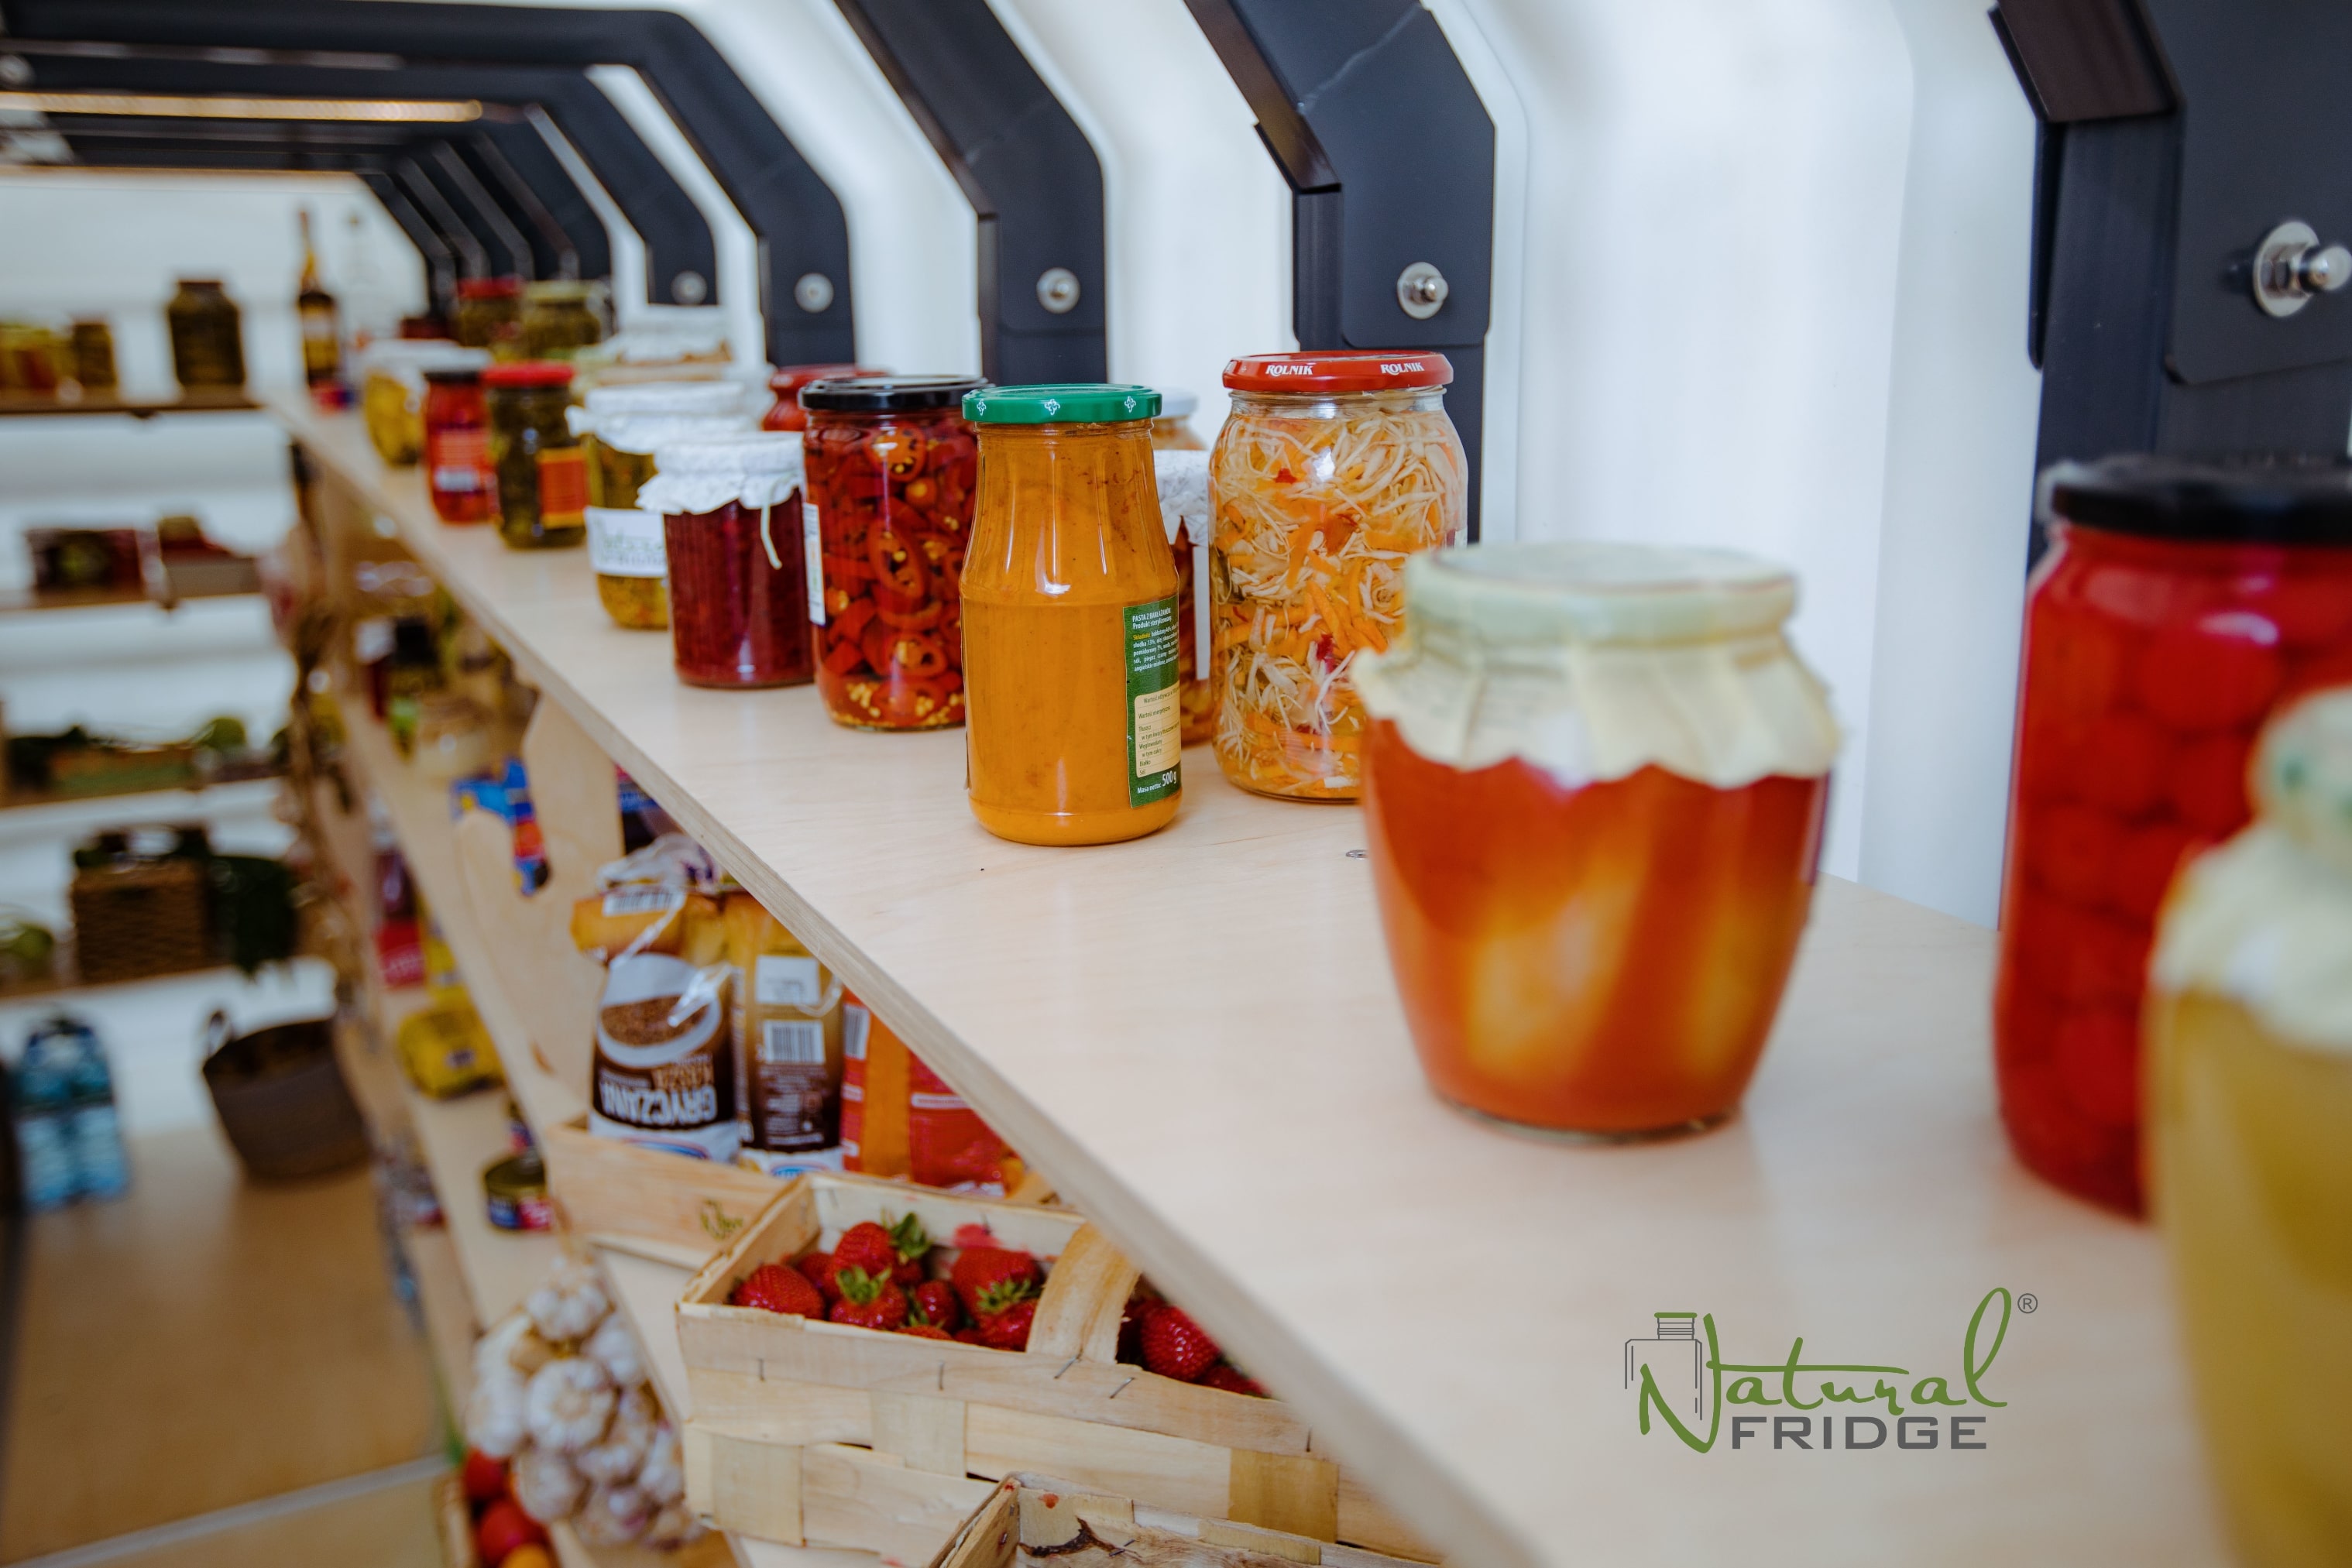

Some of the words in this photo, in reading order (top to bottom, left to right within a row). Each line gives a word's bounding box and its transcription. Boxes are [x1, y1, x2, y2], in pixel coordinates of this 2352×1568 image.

[1265, 365, 1313, 377] ROLNIK
[1380, 362, 1425, 376] ROLNIK
[1133, 620, 1150, 630] Produkt
[1138, 710, 1152, 719] Wartość
[1137, 786, 1149, 794] Masa
[1149, 782, 1162, 791] netto:
[1162, 770, 1173, 786] 500
[1173, 771, 1177, 784] g
